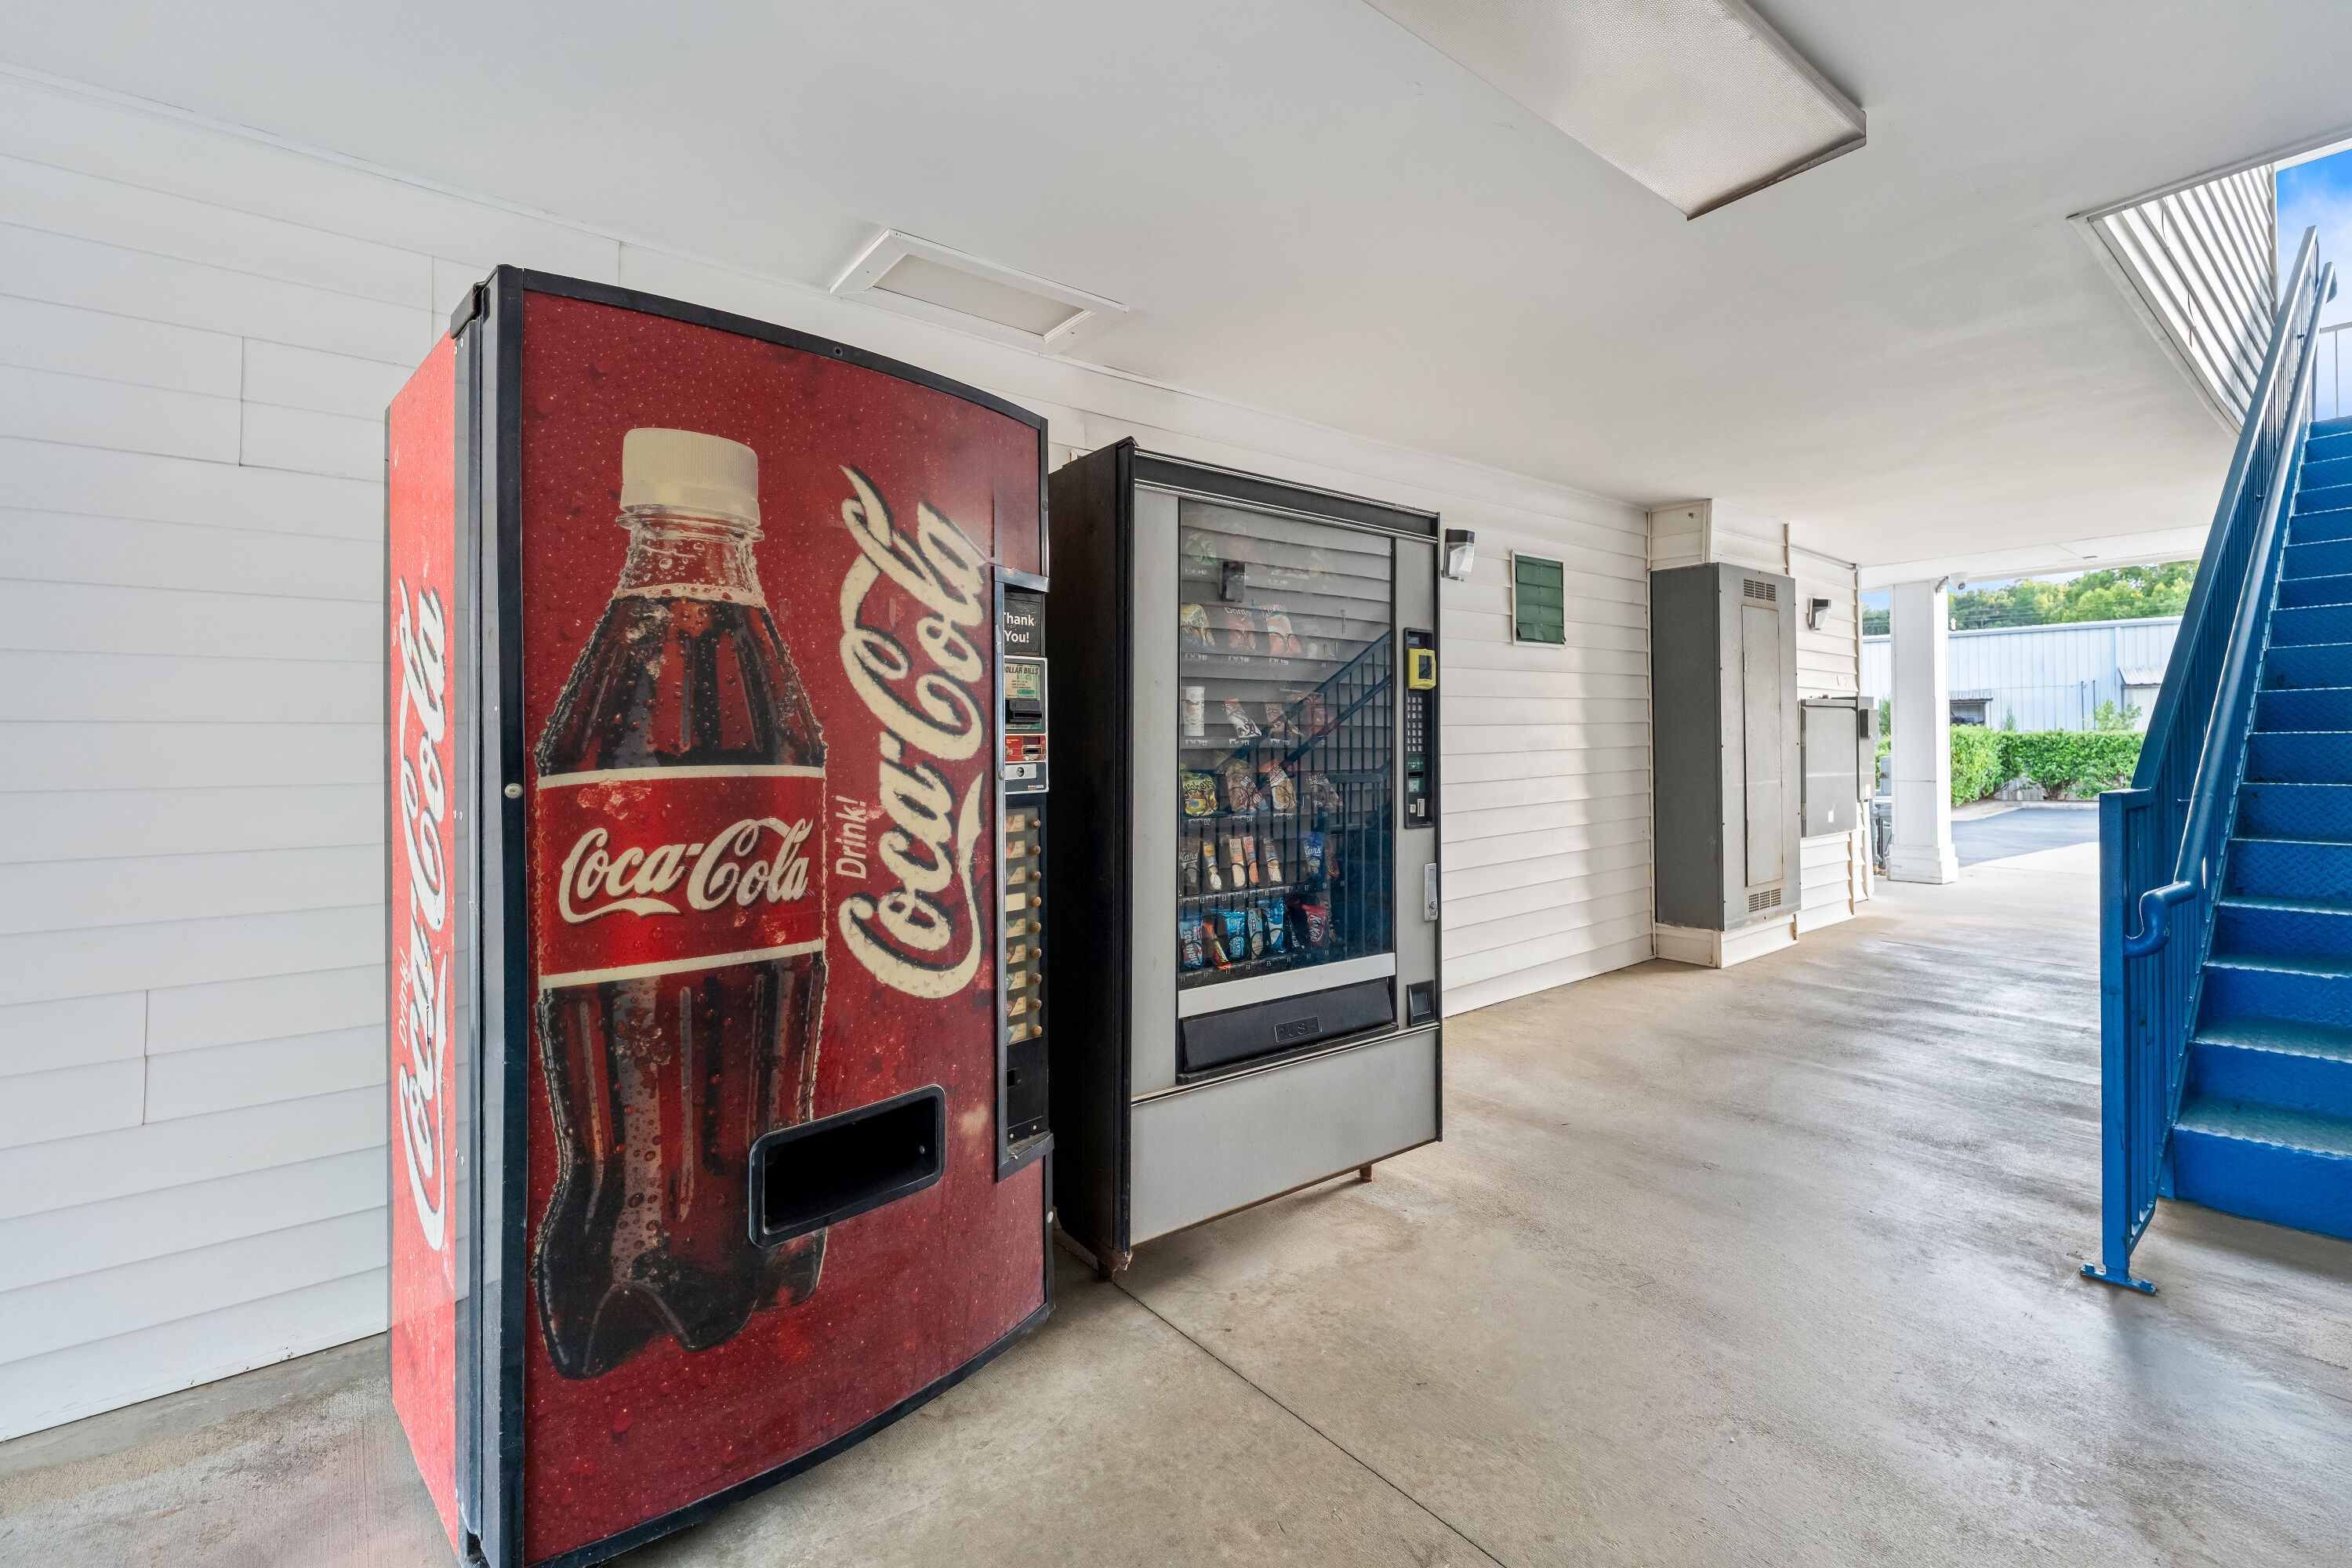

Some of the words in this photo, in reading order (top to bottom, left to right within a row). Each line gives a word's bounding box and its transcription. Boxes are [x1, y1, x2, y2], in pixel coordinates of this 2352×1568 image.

[1004, 630, 1029, 643] You!
[1023, 666, 1039, 675] BILLS
[838, 465, 988, 1000] Coca-Cola
[558, 817, 814, 925] Coca-Cola
[836, 796, 866, 879] Drink!
[399, 575, 447, 1251] Coca-Cola
[399, 948, 412, 1049] Drink!
[1278, 1020, 1316, 1040] PUSH
